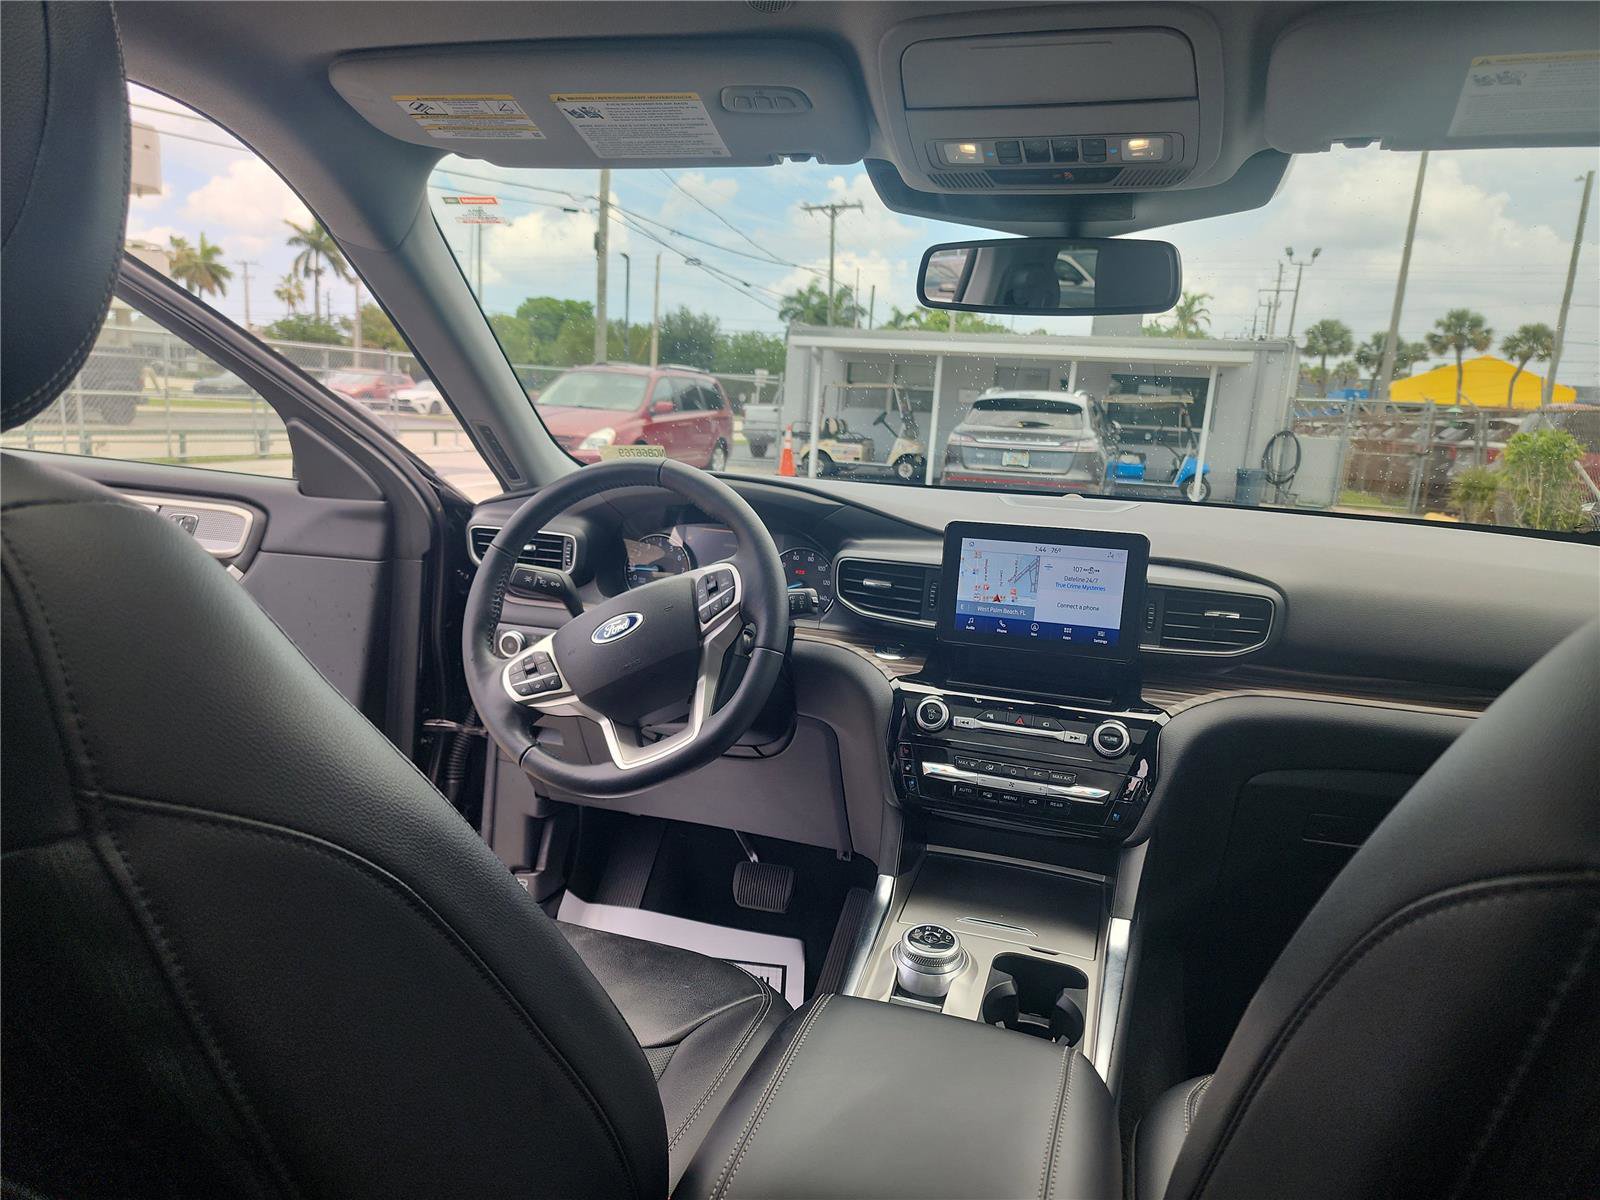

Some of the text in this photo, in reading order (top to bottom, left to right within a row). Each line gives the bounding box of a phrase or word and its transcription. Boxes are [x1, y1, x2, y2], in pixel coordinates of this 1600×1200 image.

[1082, 584, 1106, 592] Mysteries
[1056, 602, 1078, 610] Connect
[1083, 604, 1100, 612] phone
